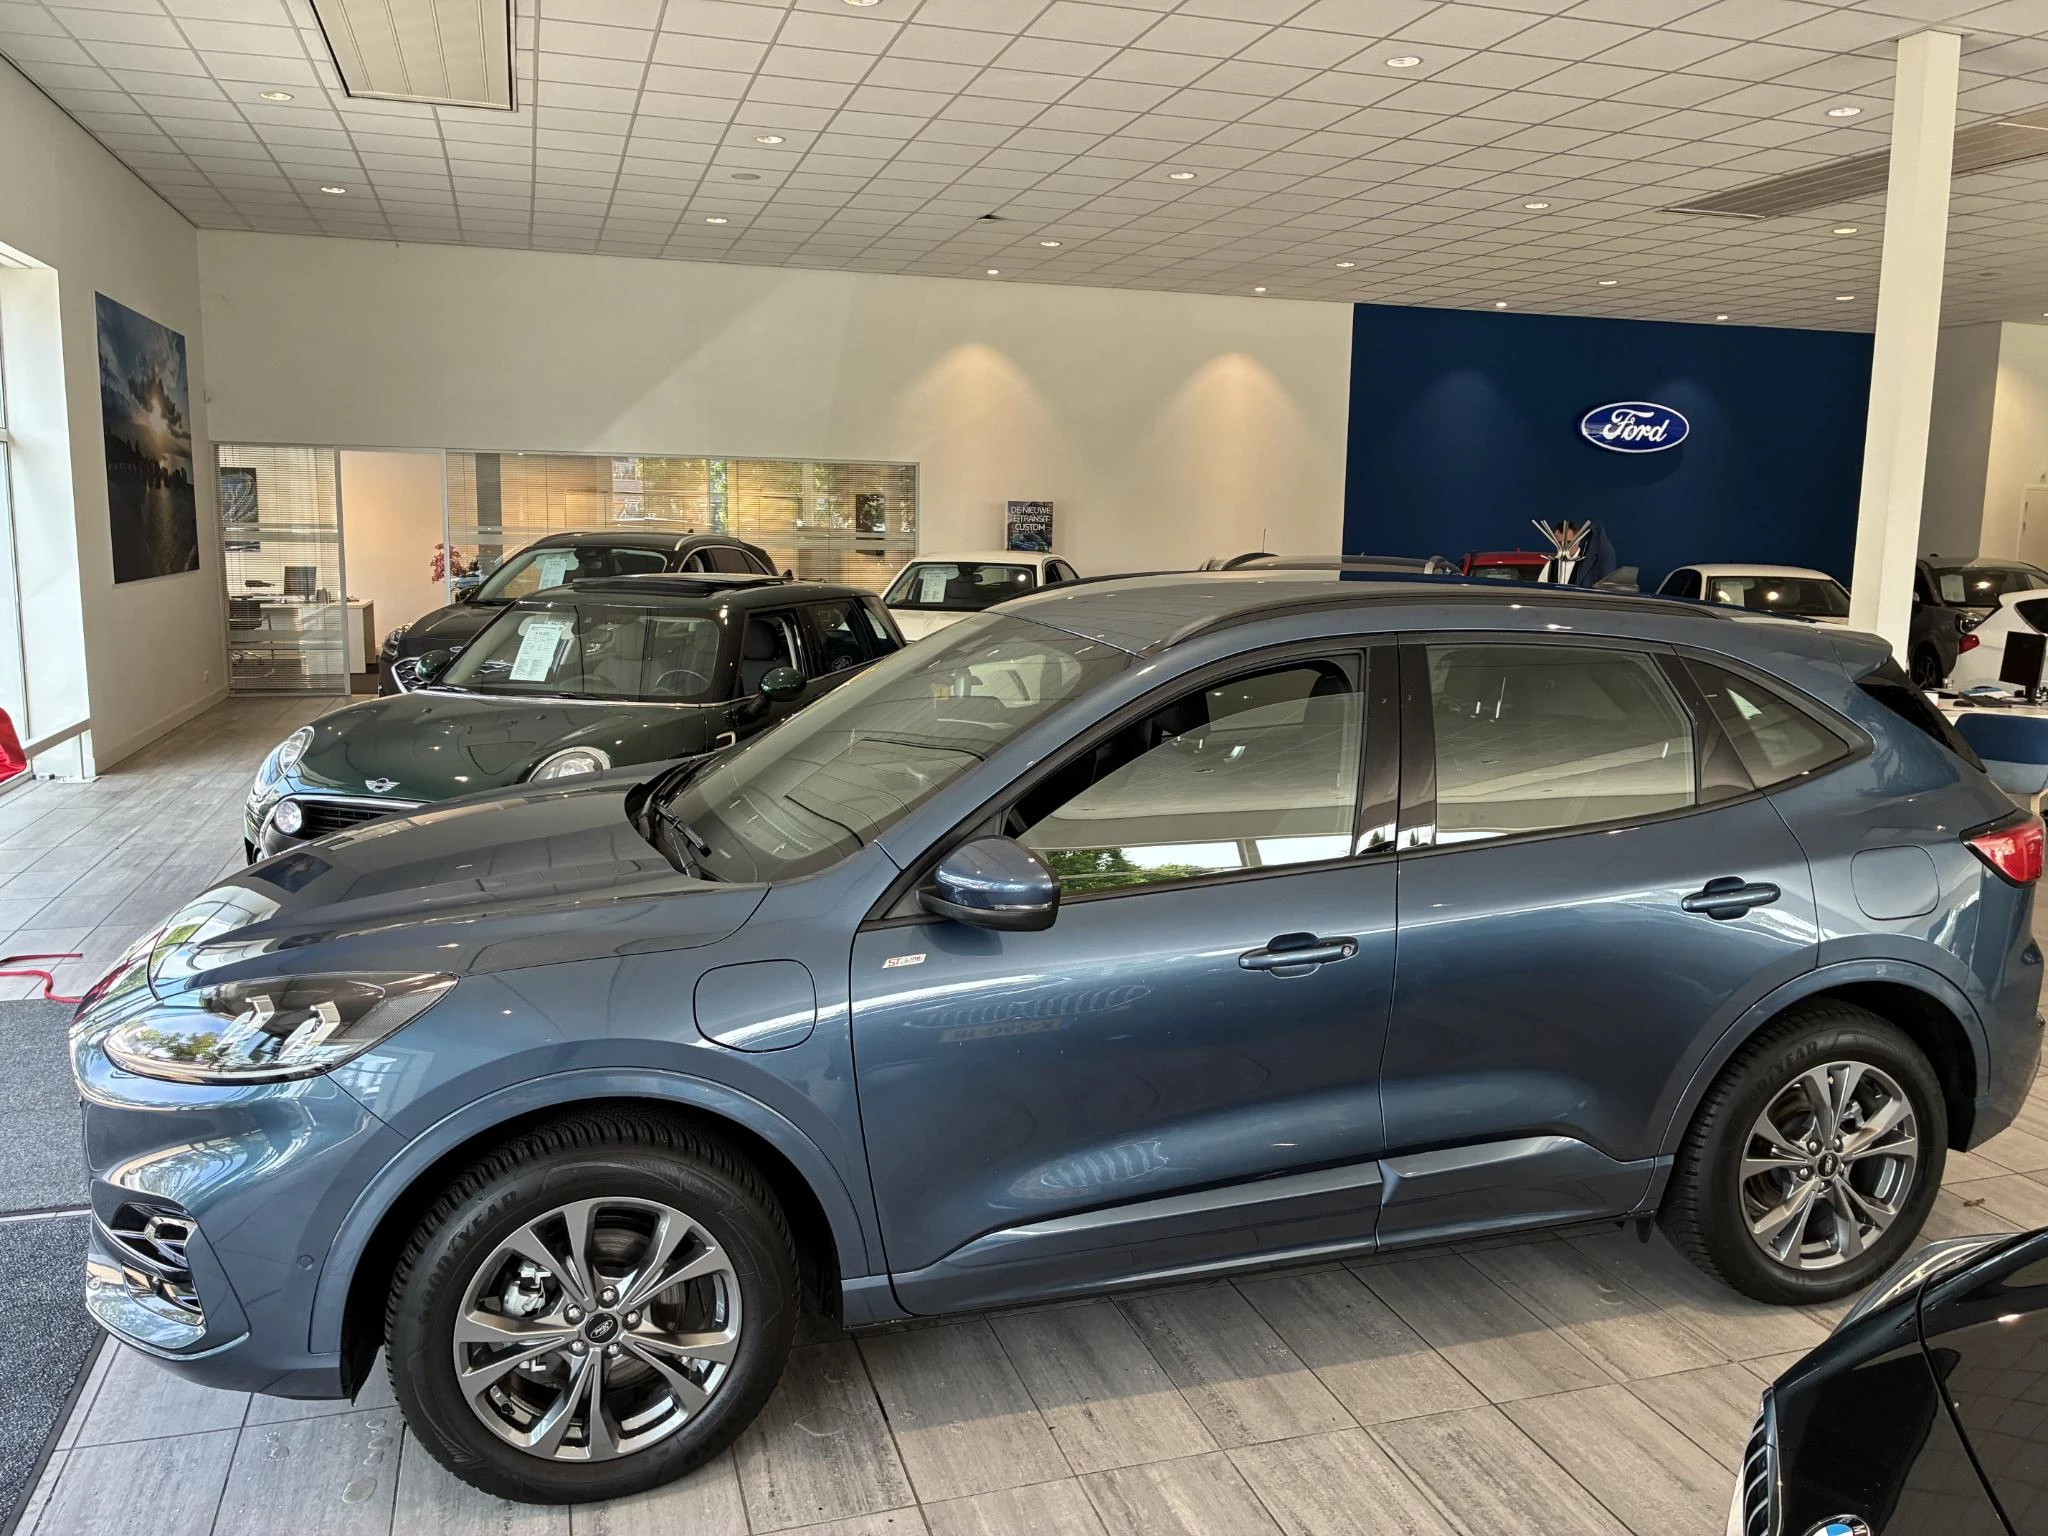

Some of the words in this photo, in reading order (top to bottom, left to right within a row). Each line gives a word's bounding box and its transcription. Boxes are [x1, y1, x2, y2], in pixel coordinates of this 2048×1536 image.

[1602, 408, 1670, 442] Ford
[1010, 506, 1022, 514] DE
[1022, 506, 1051, 514] NIEUWE
[1014, 523, 1046, 531] CUSTOM
[417, 1190, 517, 1325] GOODYEAR
